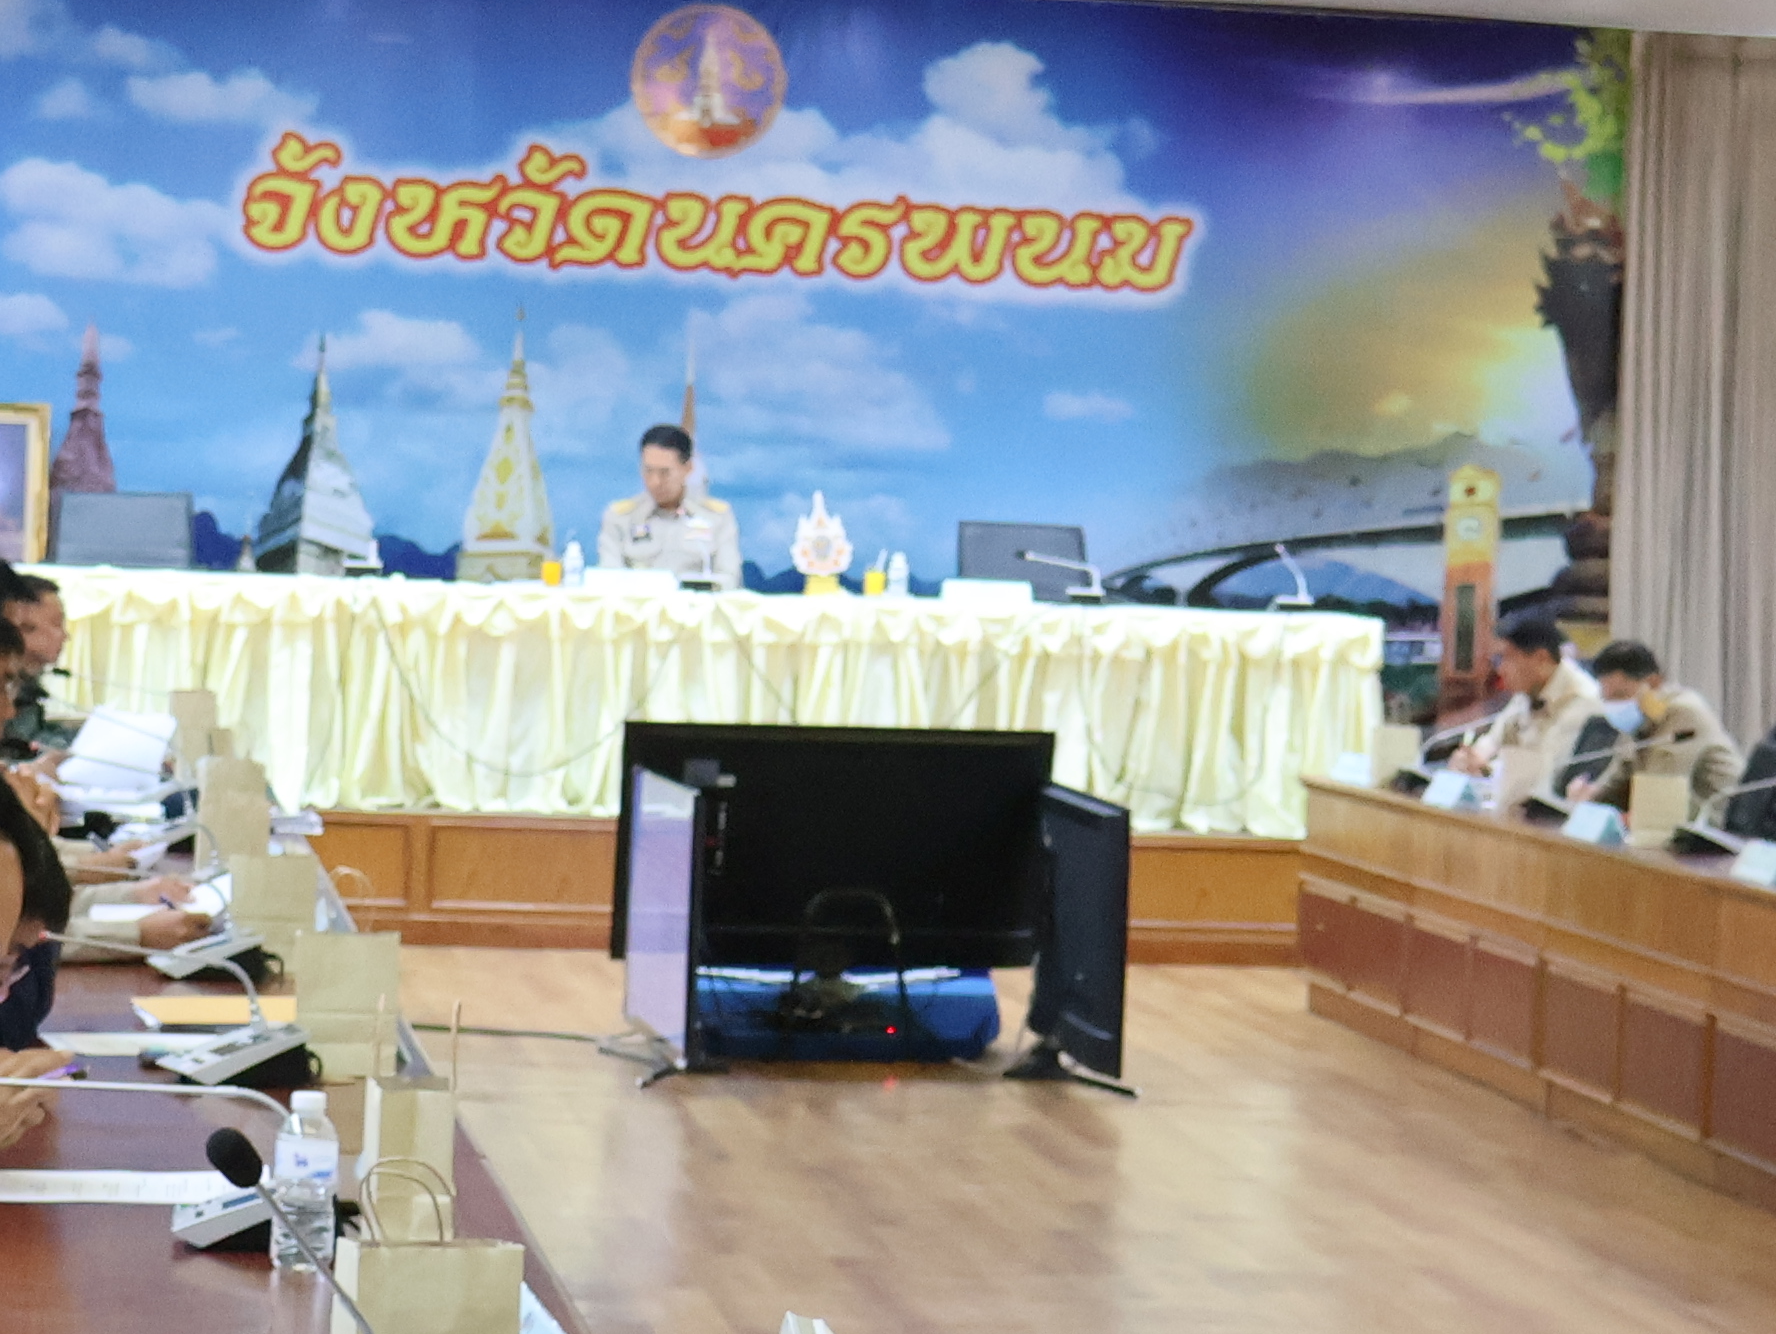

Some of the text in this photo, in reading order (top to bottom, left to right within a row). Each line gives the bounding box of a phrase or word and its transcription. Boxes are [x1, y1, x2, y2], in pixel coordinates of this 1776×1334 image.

[242, 131, 1195, 293] จังหวัดนครพนม
